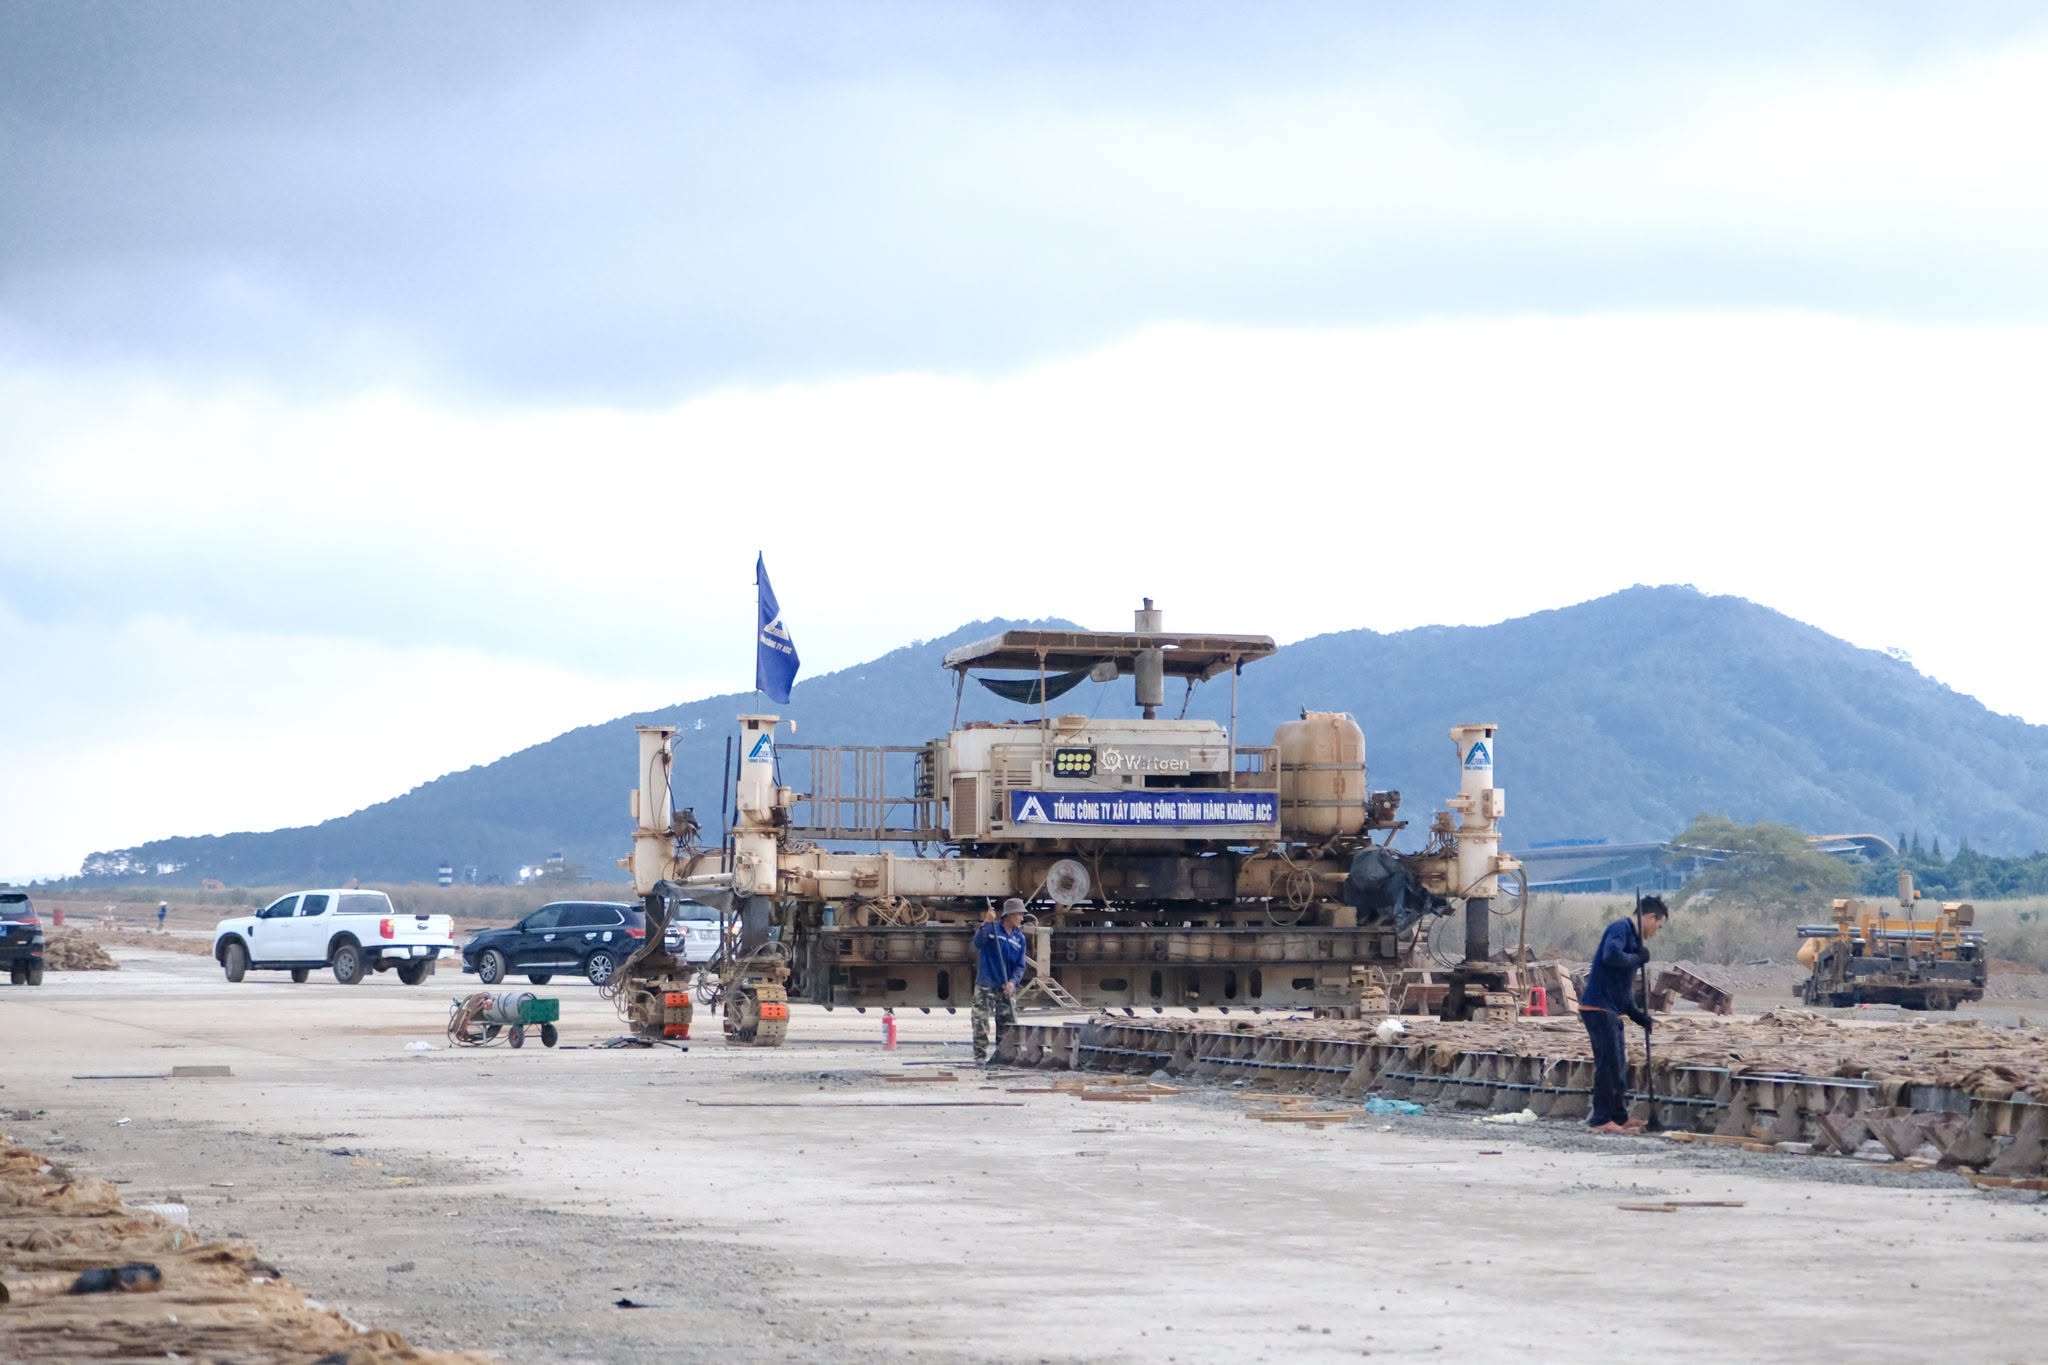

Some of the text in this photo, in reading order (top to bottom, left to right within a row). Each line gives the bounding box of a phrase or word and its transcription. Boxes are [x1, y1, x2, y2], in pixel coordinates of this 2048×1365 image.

[1054, 796, 1272, 823] TỔNG CÔNG TY XÂY DỰNG CÔNG TRÌNH HÀNG KHÔNG ACC
